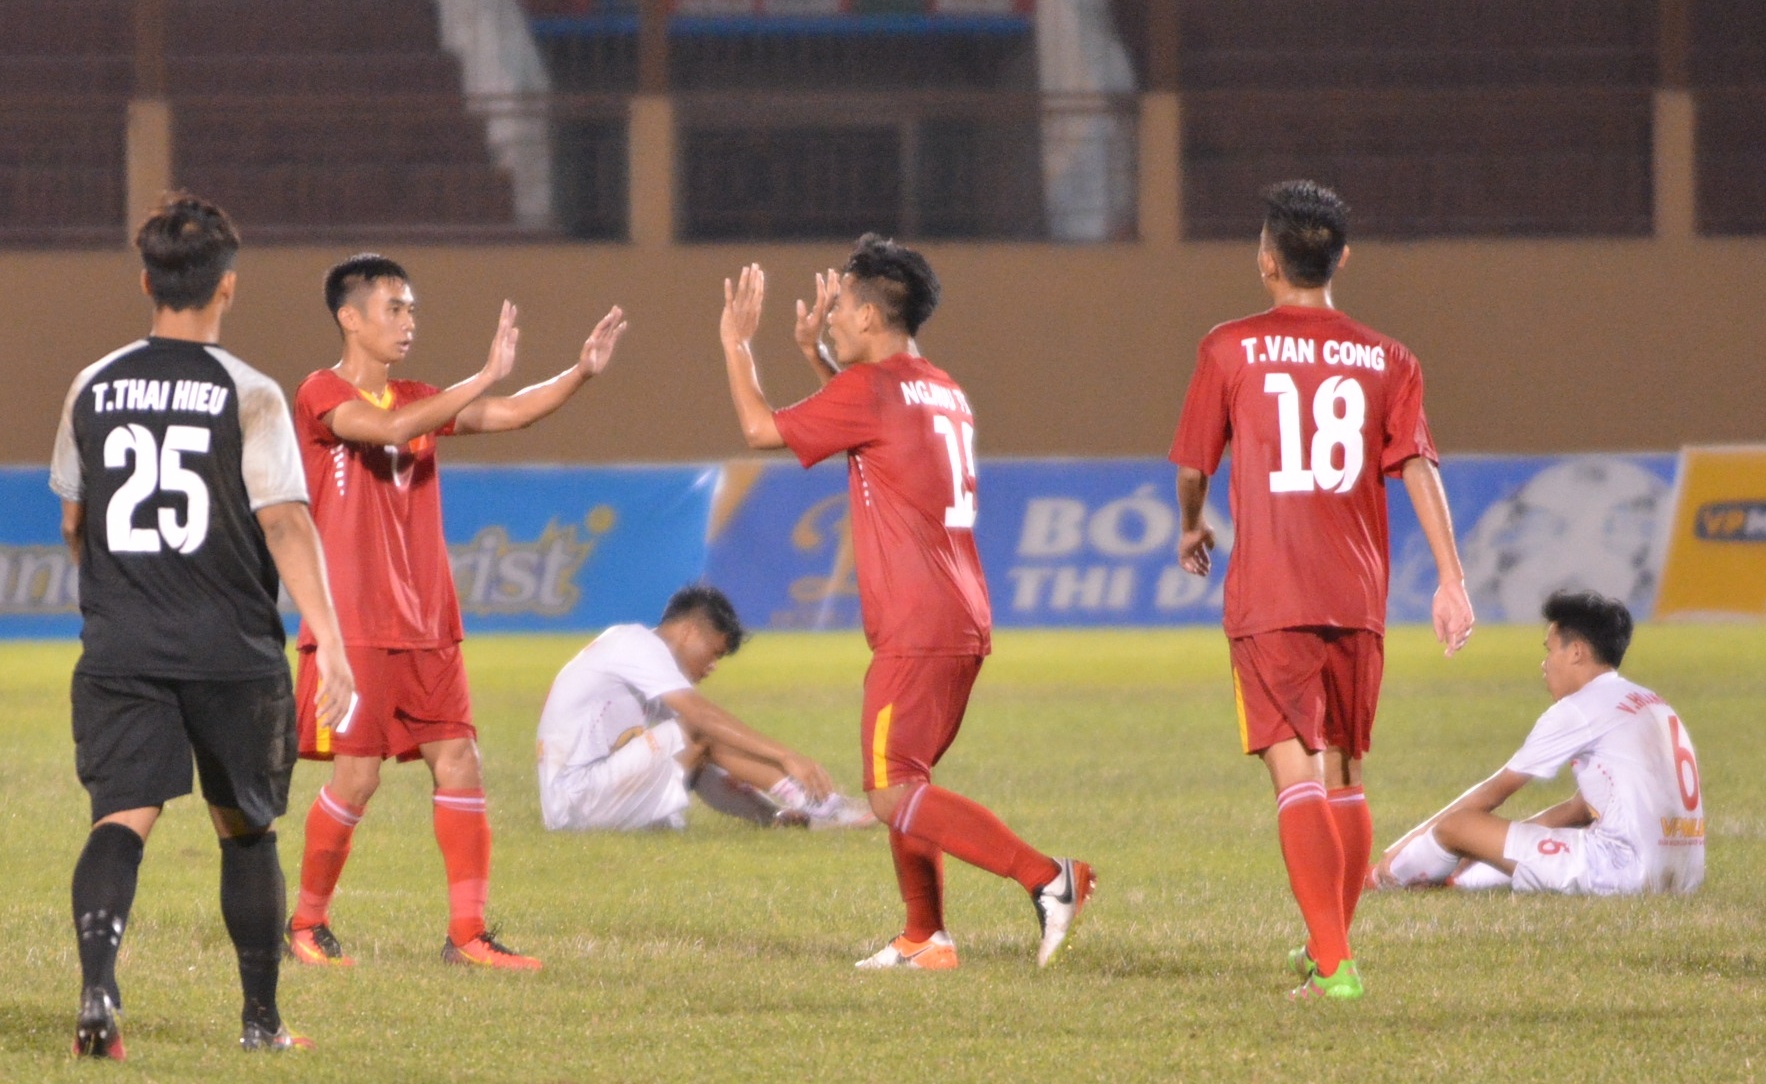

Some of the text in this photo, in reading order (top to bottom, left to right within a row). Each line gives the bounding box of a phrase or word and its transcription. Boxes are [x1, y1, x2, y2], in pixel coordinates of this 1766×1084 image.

[1241, 335, 1385, 371] T.VAN CONG
[92, 379, 228, 415] T.THAI HIEU
[1264, 373, 1366, 494] 18
[104, 423, 211, 555] 25
[1007, 566, 1134, 611] THI
[1668, 715, 1699, 812] 6
